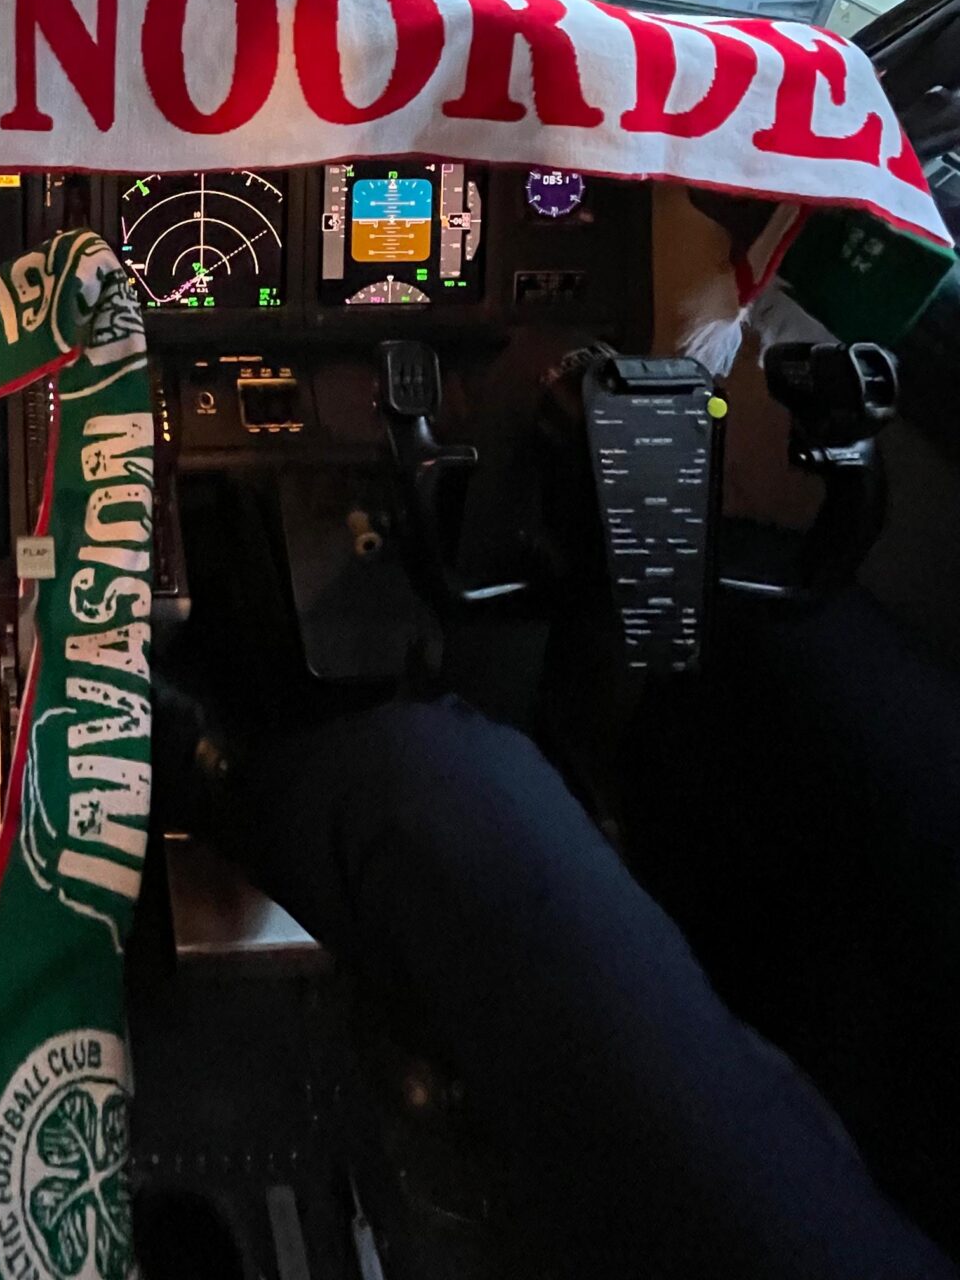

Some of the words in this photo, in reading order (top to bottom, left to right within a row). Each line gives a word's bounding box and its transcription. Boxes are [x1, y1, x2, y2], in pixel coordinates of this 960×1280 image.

[22, 548, 49, 557] FLAP
[56, 411, 155, 902] INVASION
[47, 1039, 103, 1077] CLUB
